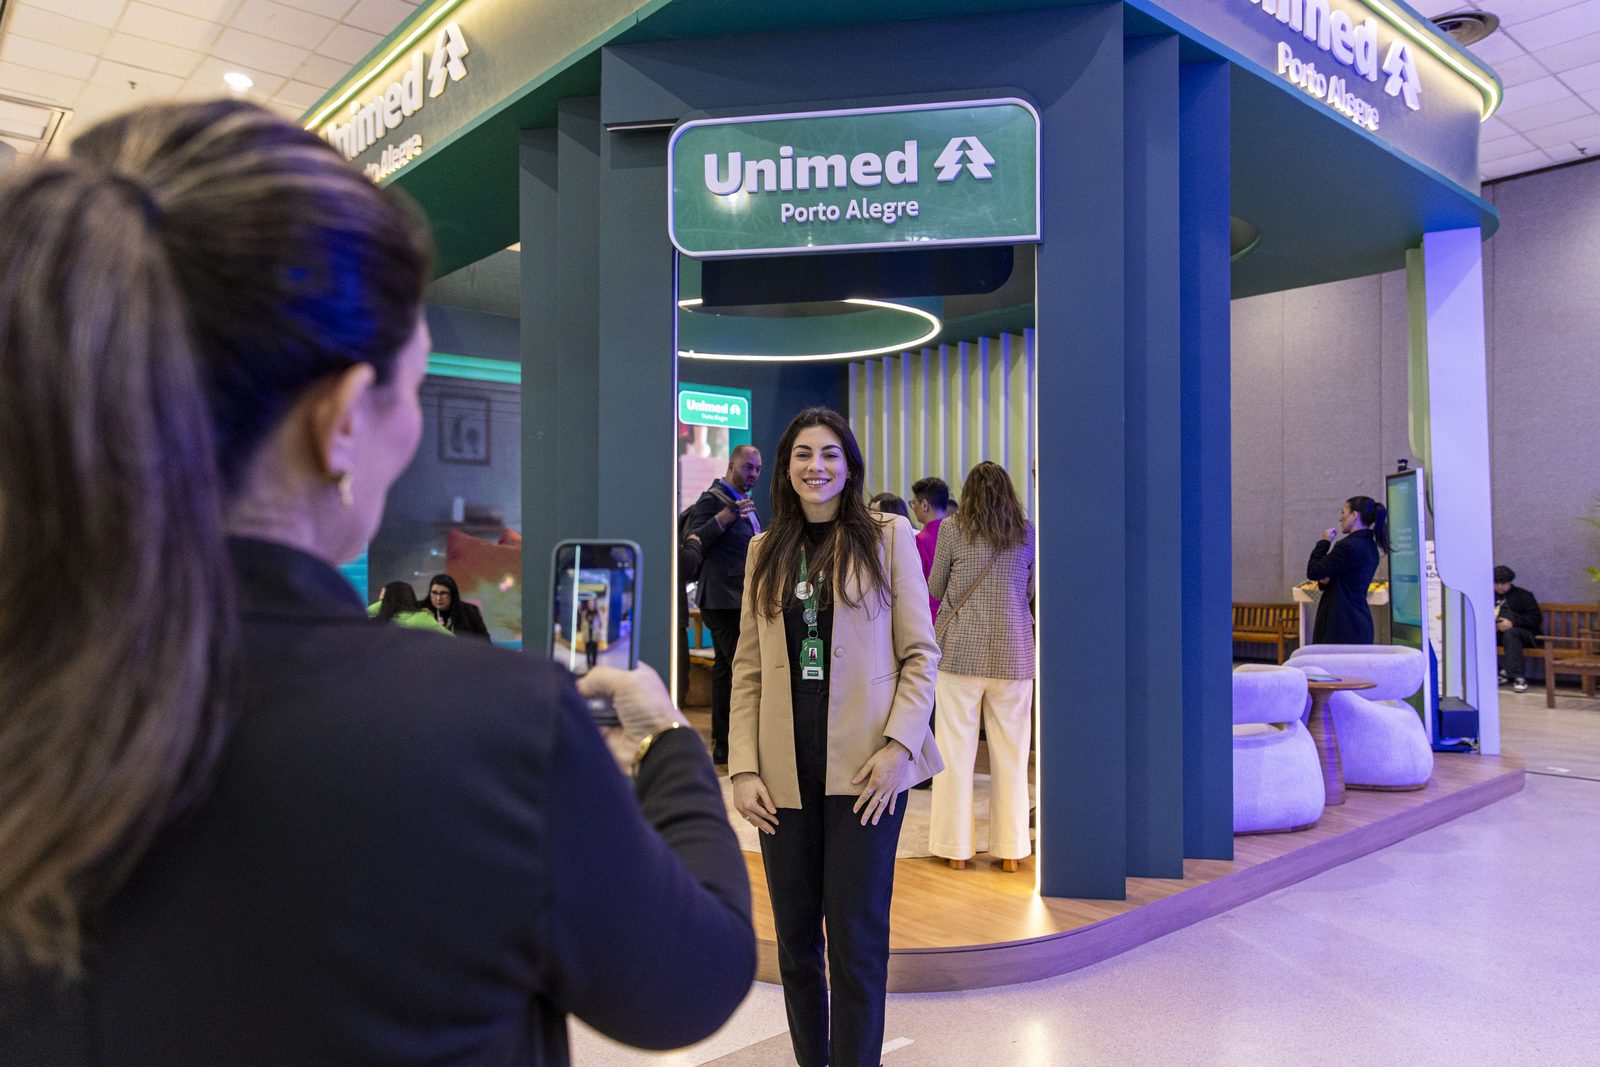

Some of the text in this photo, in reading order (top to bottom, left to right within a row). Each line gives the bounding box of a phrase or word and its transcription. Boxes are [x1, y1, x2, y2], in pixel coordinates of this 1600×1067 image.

[327, 50, 424, 161] nimed
[1278, 41, 1379, 131] Porto Alegre
[381, 133, 422, 178] Alegre
[704, 140, 919, 196] Unimed
[780, 198, 919, 224] Porto Alegre
